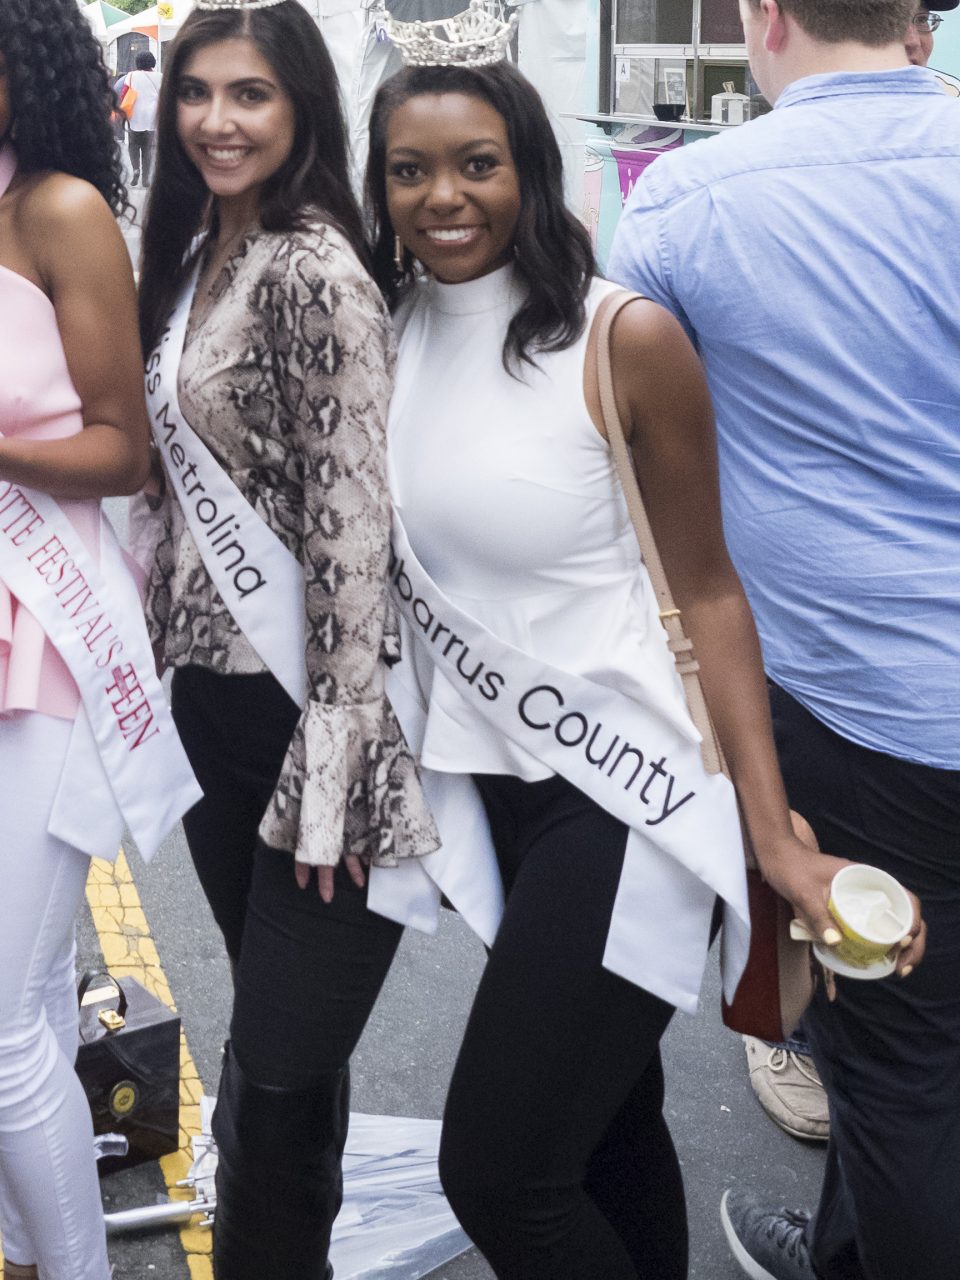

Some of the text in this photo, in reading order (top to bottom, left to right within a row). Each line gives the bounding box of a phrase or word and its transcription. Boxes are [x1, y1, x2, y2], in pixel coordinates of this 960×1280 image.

[621, 63, 626, 75] A
[155, 402, 267, 599] Metrolina
[27, 533, 124, 669] FESTIVAL'S
[105, 662, 161, 752] TEEN
[390, 558, 696, 826] barrus County
